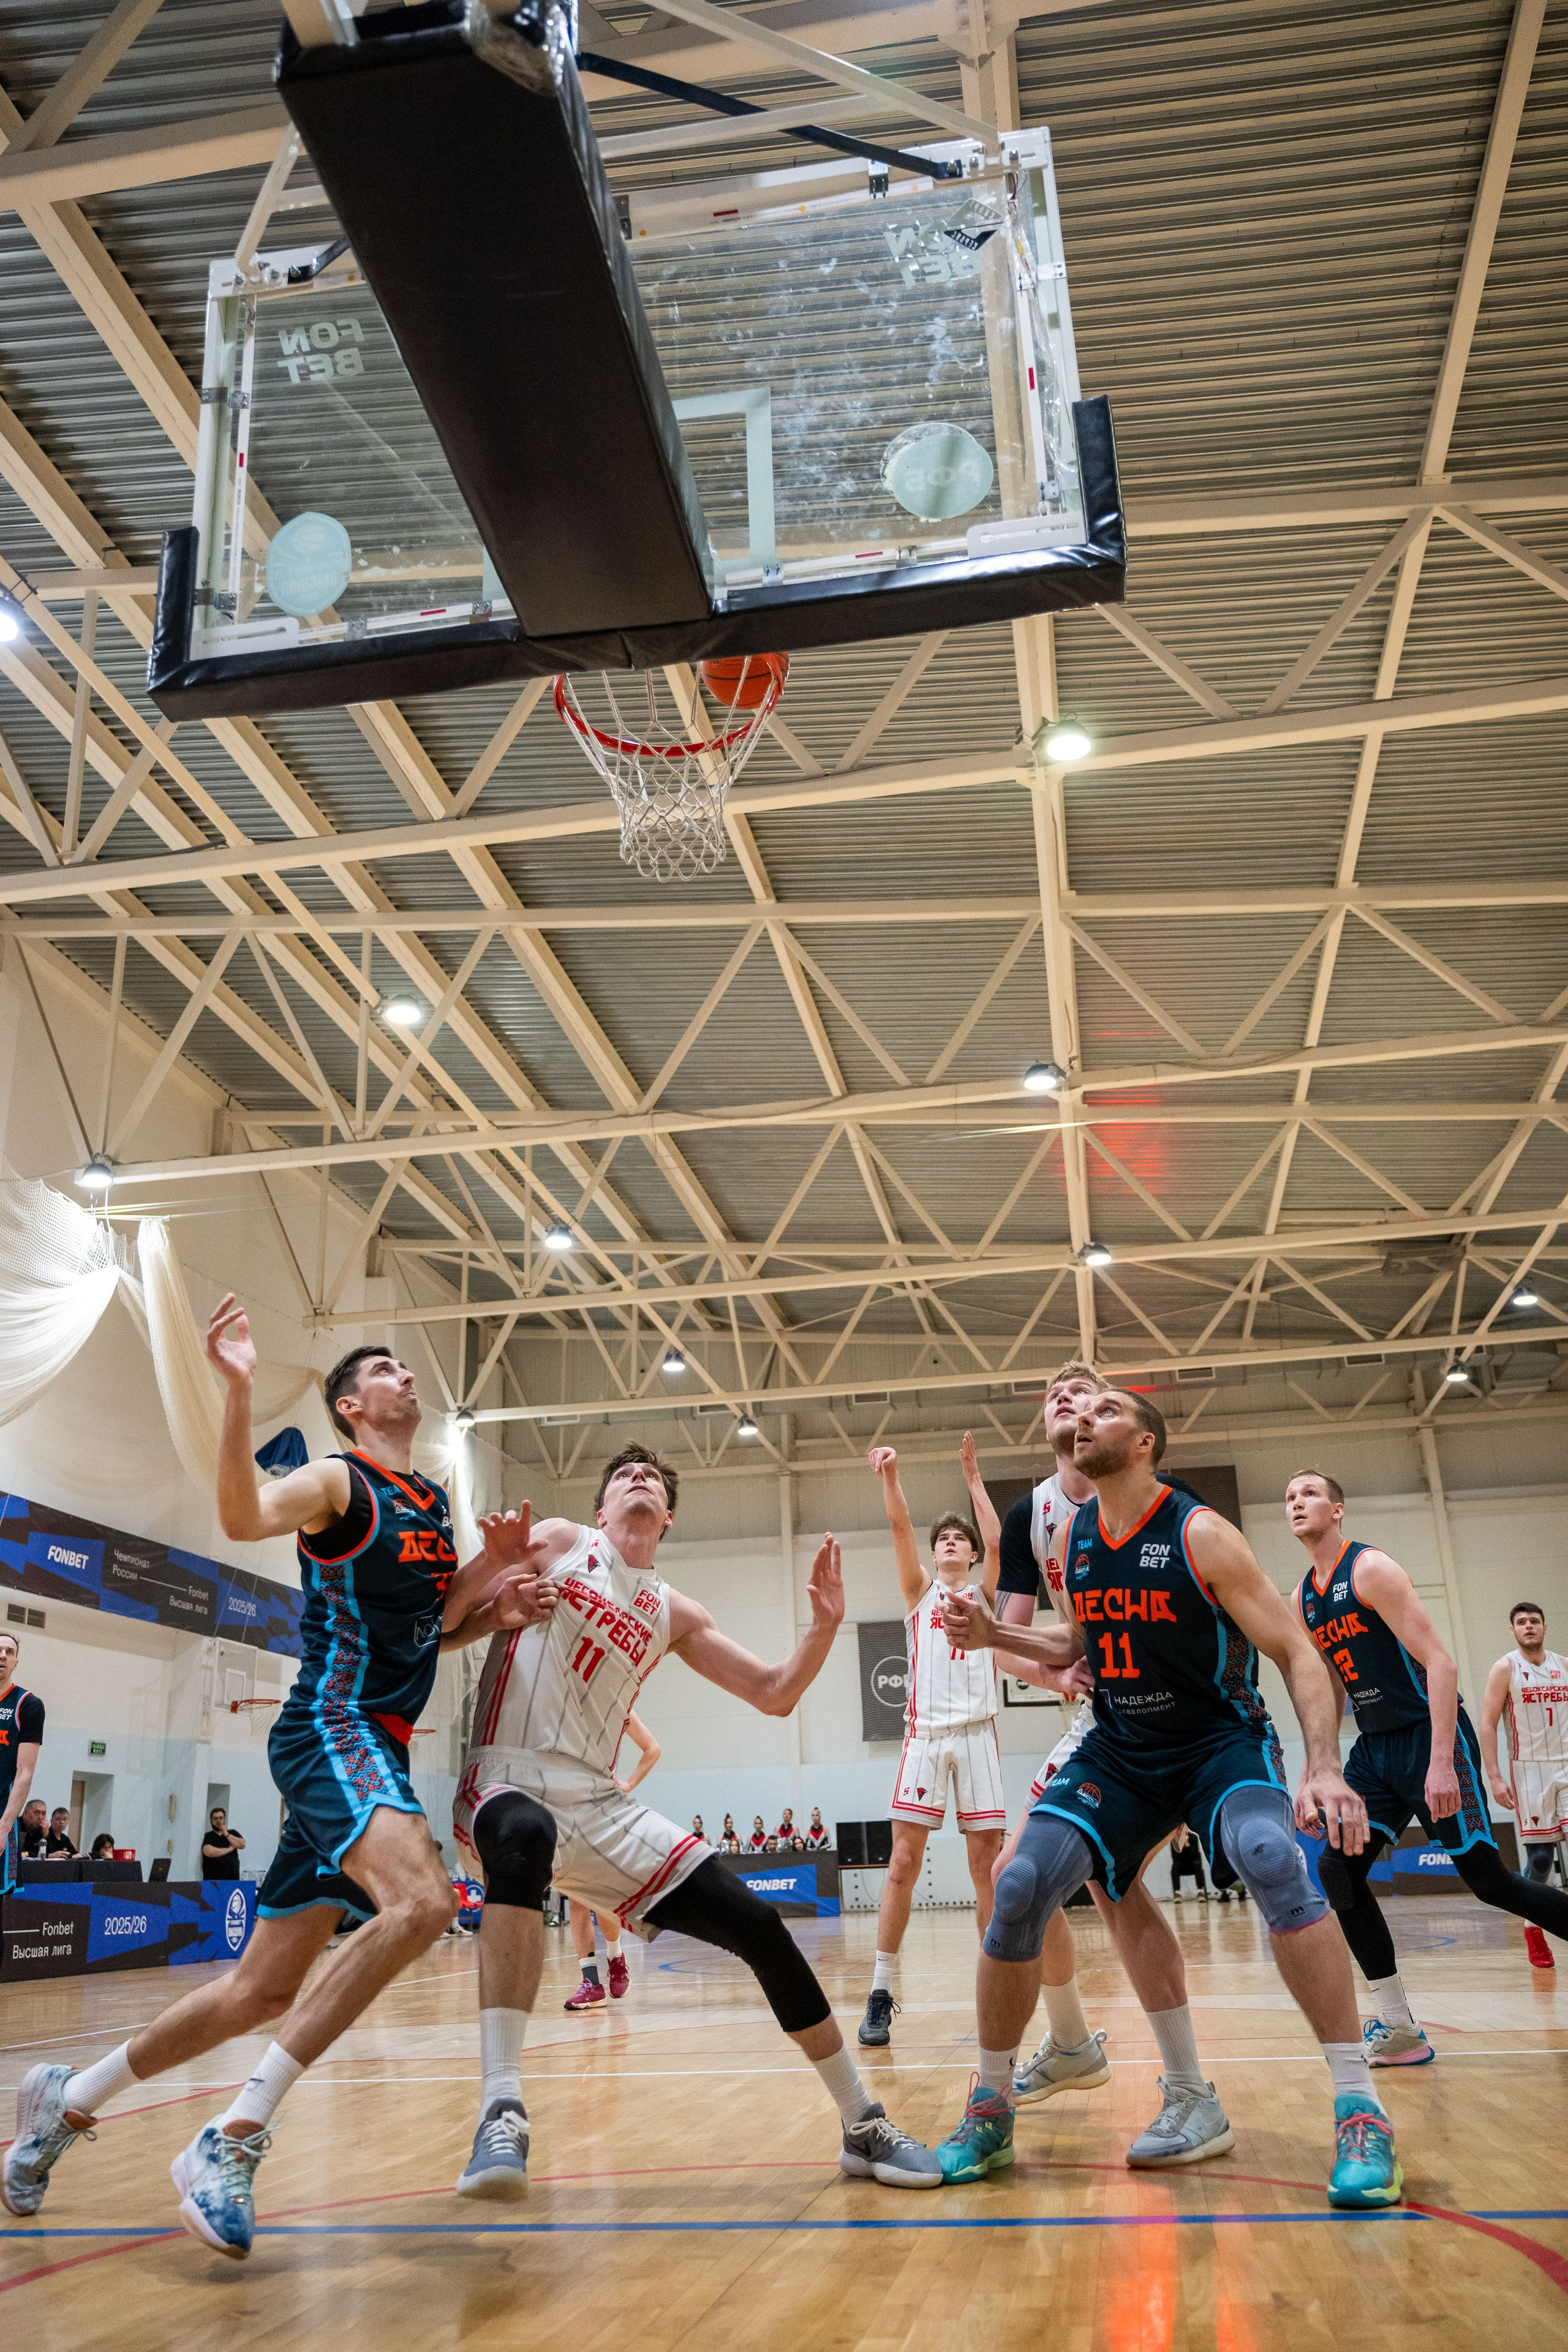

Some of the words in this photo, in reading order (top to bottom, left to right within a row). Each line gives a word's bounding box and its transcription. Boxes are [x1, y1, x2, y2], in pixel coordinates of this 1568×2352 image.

[380, 1485, 402, 1496] TEA
[398, 1531, 459, 1562] ДЕС
[1077, 1537, 1093, 1550] TEAM
[1140, 1543, 1171, 1556] FON
[47, 1545, 89, 1570] FONBET
[114, 1548, 151, 1569] Чемпионат
[1139, 1555, 1170, 1569] BET
[112, 1564, 138, 1581] России
[188, 1585, 209, 1601] Fonbet
[1332, 1581, 1348, 1594] FON
[638, 1589, 661, 1609] FON
[1333, 1589, 1348, 1602] BET
[169, 1595, 194, 1611] Высшая
[194, 1604, 208, 1616] лига
[228, 1596, 257, 1618] 2025/26
[633, 1597, 658, 1616] BET
[1072, 1588, 1177, 1623] ДЕСНА
[571, 1635, 606, 1684] 11
[1098, 1632, 1140, 1678] 11
[1114, 1691, 1174, 1706] НАДЕЖДА
[1117, 1702, 1176, 1715] ЕВЕЛОПМЕНТ
[1545, 1708, 1553, 1727] 1
[1049, 1777, 1070, 1787] TEAM
[1418, 1853, 1454, 1866] FONB
[746, 1878, 797, 1891] FONBET
[42, 1921, 74, 1936] Fonbet
[104, 1915, 147, 1936] 2025/26
[12, 1944, 49, 1959] Высшая
[51, 1943, 72, 1956] лига
